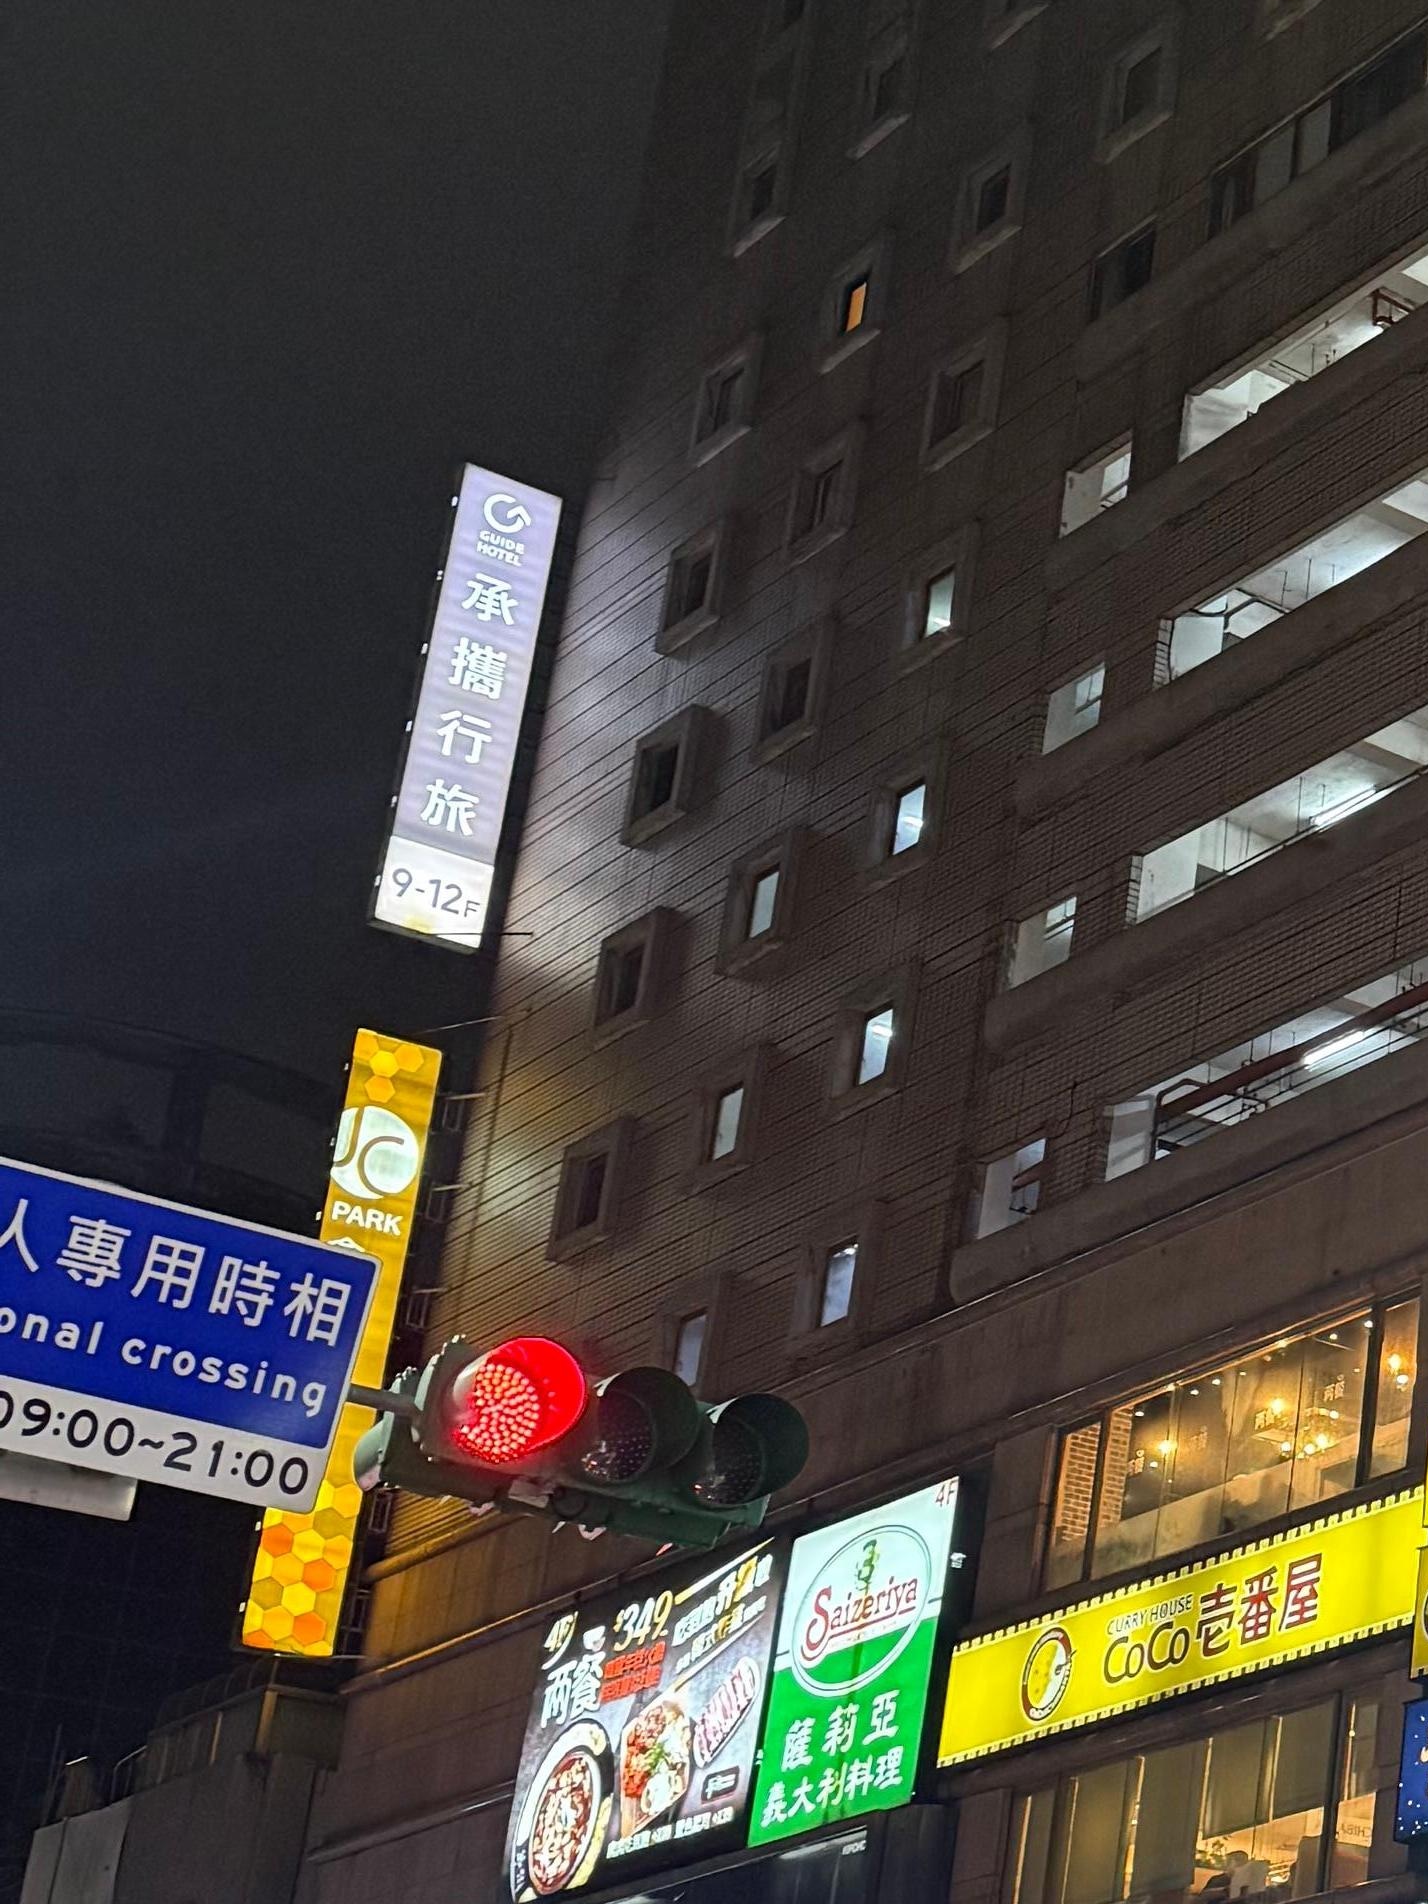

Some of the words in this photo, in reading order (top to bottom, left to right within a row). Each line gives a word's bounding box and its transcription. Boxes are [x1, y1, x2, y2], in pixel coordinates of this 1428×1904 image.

[476, 540, 522, 567] HOTEL
[479, 529, 525, 555] GUIDE
[418, 571, 520, 838] 承攜行旅
[390, 866, 481, 920] 9-12F
[331, 1201, 403, 1237] PARK
[121, 1336, 327, 1418] crossing
[935, 1477, 958, 1508] 4F
[803, 1576, 919, 1656] Saizeriya
[1106, 1609, 1149, 1635] CURRY
[1149, 1593, 1194, 1623] HOUSE
[780, 1688, 901, 1773] 薩莉亞
[760, 1745, 905, 1829] 義大利料理
